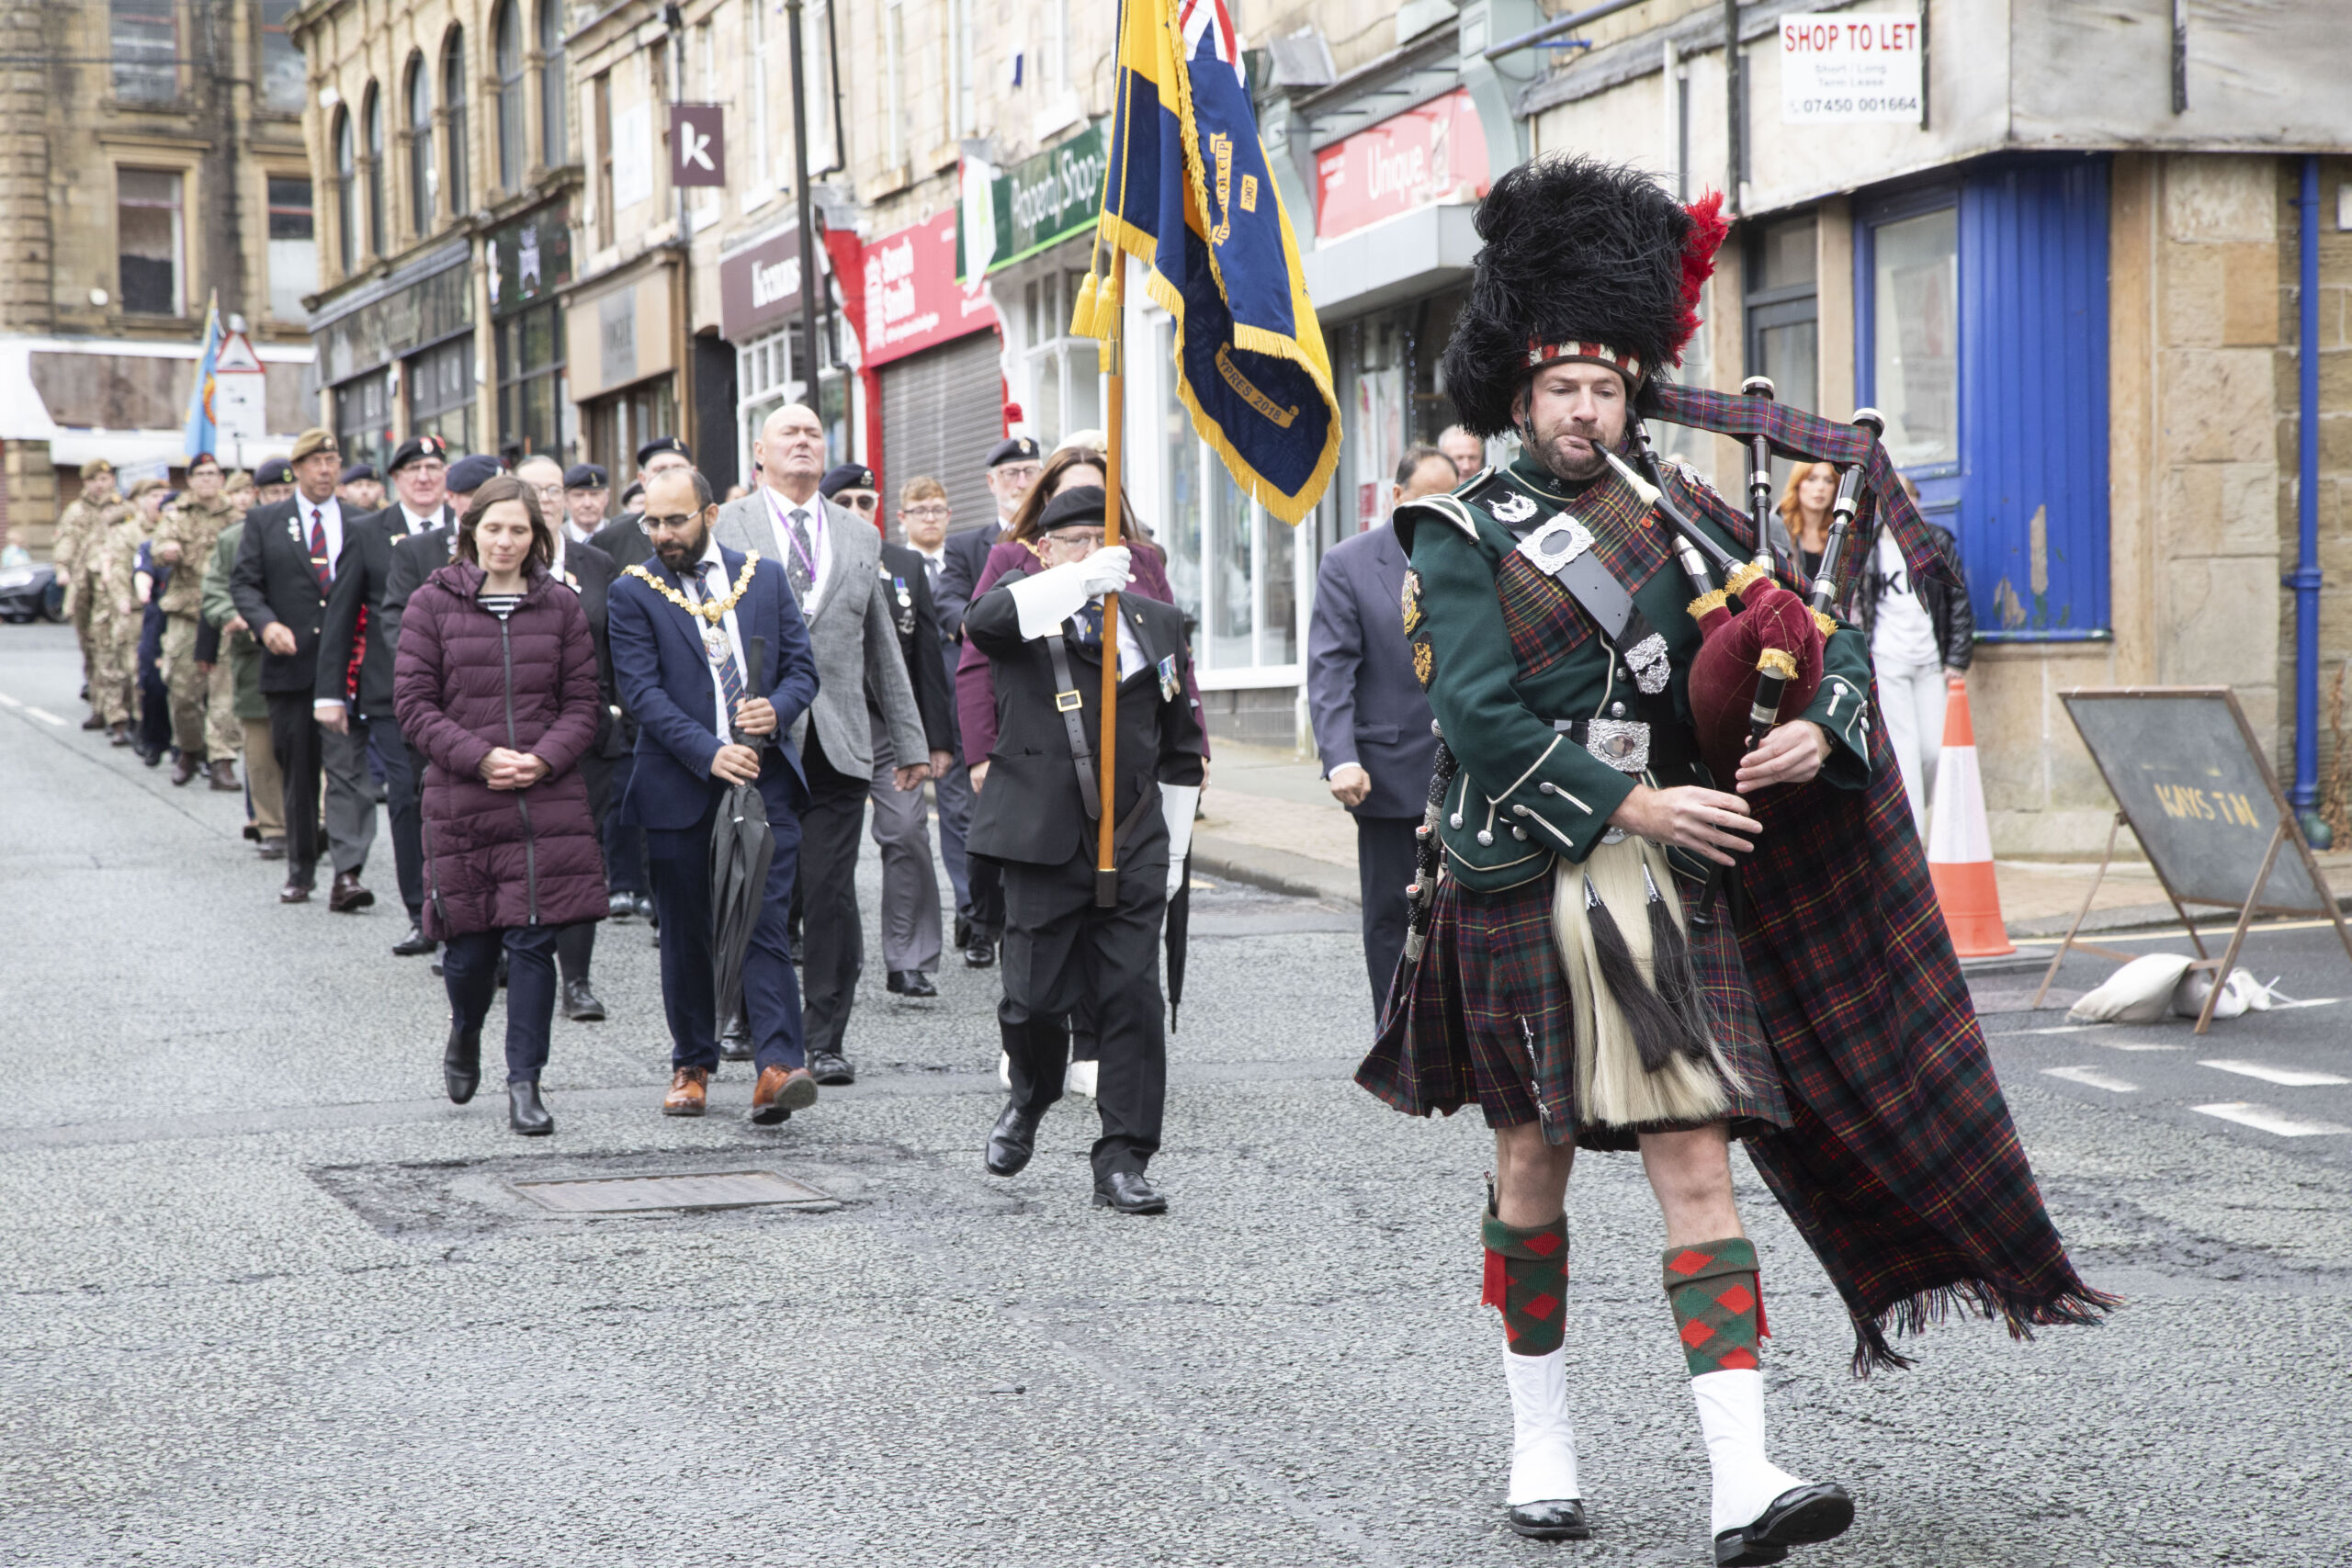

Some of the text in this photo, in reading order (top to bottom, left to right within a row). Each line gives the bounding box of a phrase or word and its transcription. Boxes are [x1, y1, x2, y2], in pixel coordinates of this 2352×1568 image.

[1785, 23, 1917, 52] SHOP TO LET
[1815, 62, 1848, 74] Short
[1857, 62, 1888, 75] Long
[1804, 96, 1917, 113] 07450 001664
[1218, 142, 1230, 171] CUP
[1367, 137, 1424, 204] Unique
[1060, 148, 1098, 214] Shop
[1244, 178, 1255, 208] 2007
[1219, 356, 1283, 421] YPRES 2018
